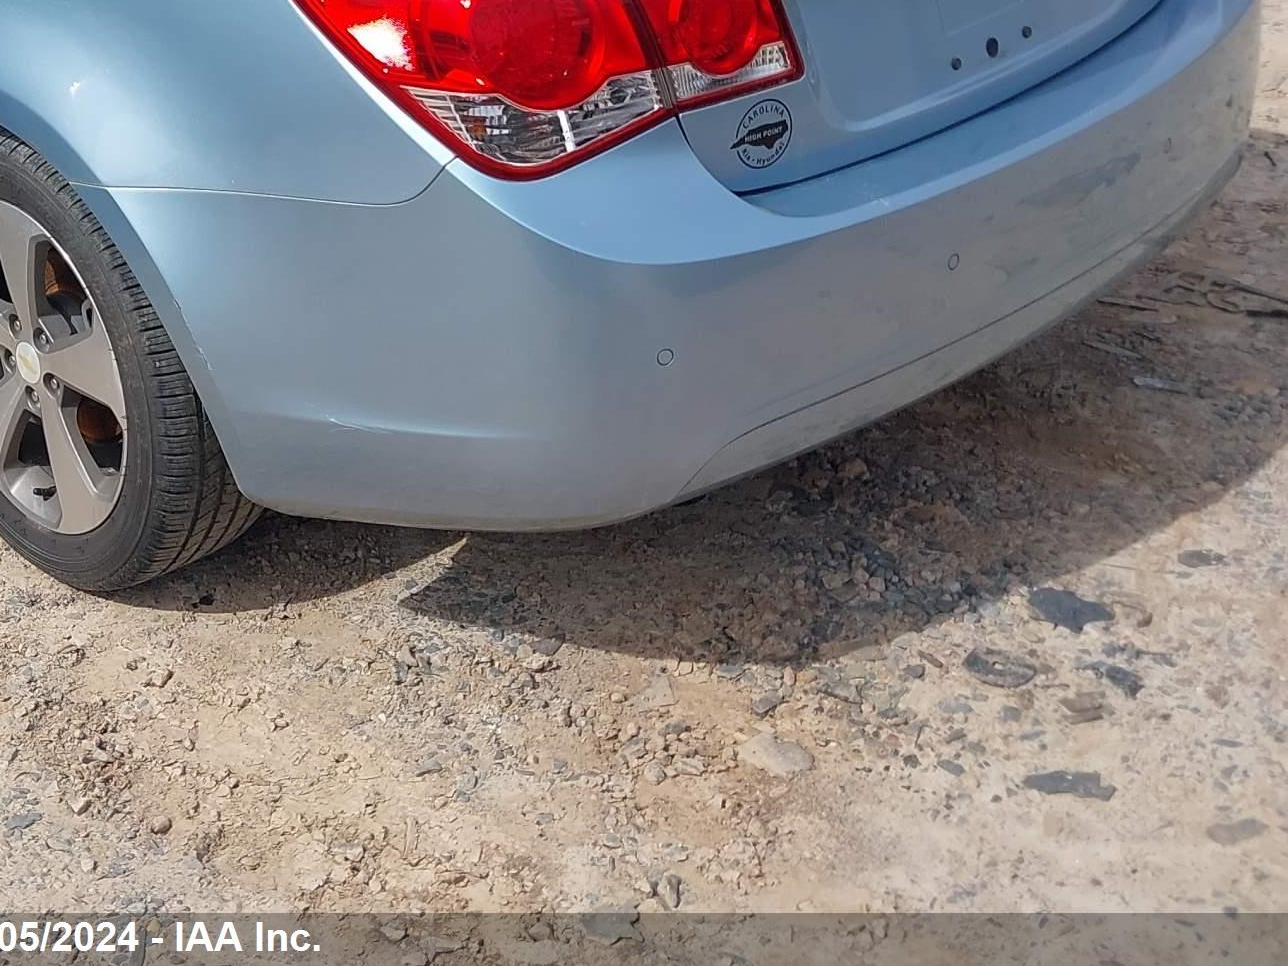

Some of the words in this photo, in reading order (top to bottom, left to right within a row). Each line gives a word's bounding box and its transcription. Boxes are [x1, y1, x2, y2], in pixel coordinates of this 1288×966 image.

[742, 105, 785, 129] CAROLINA
[744, 132, 762, 144] HIGH
[763, 126, 783, 138] POINT
